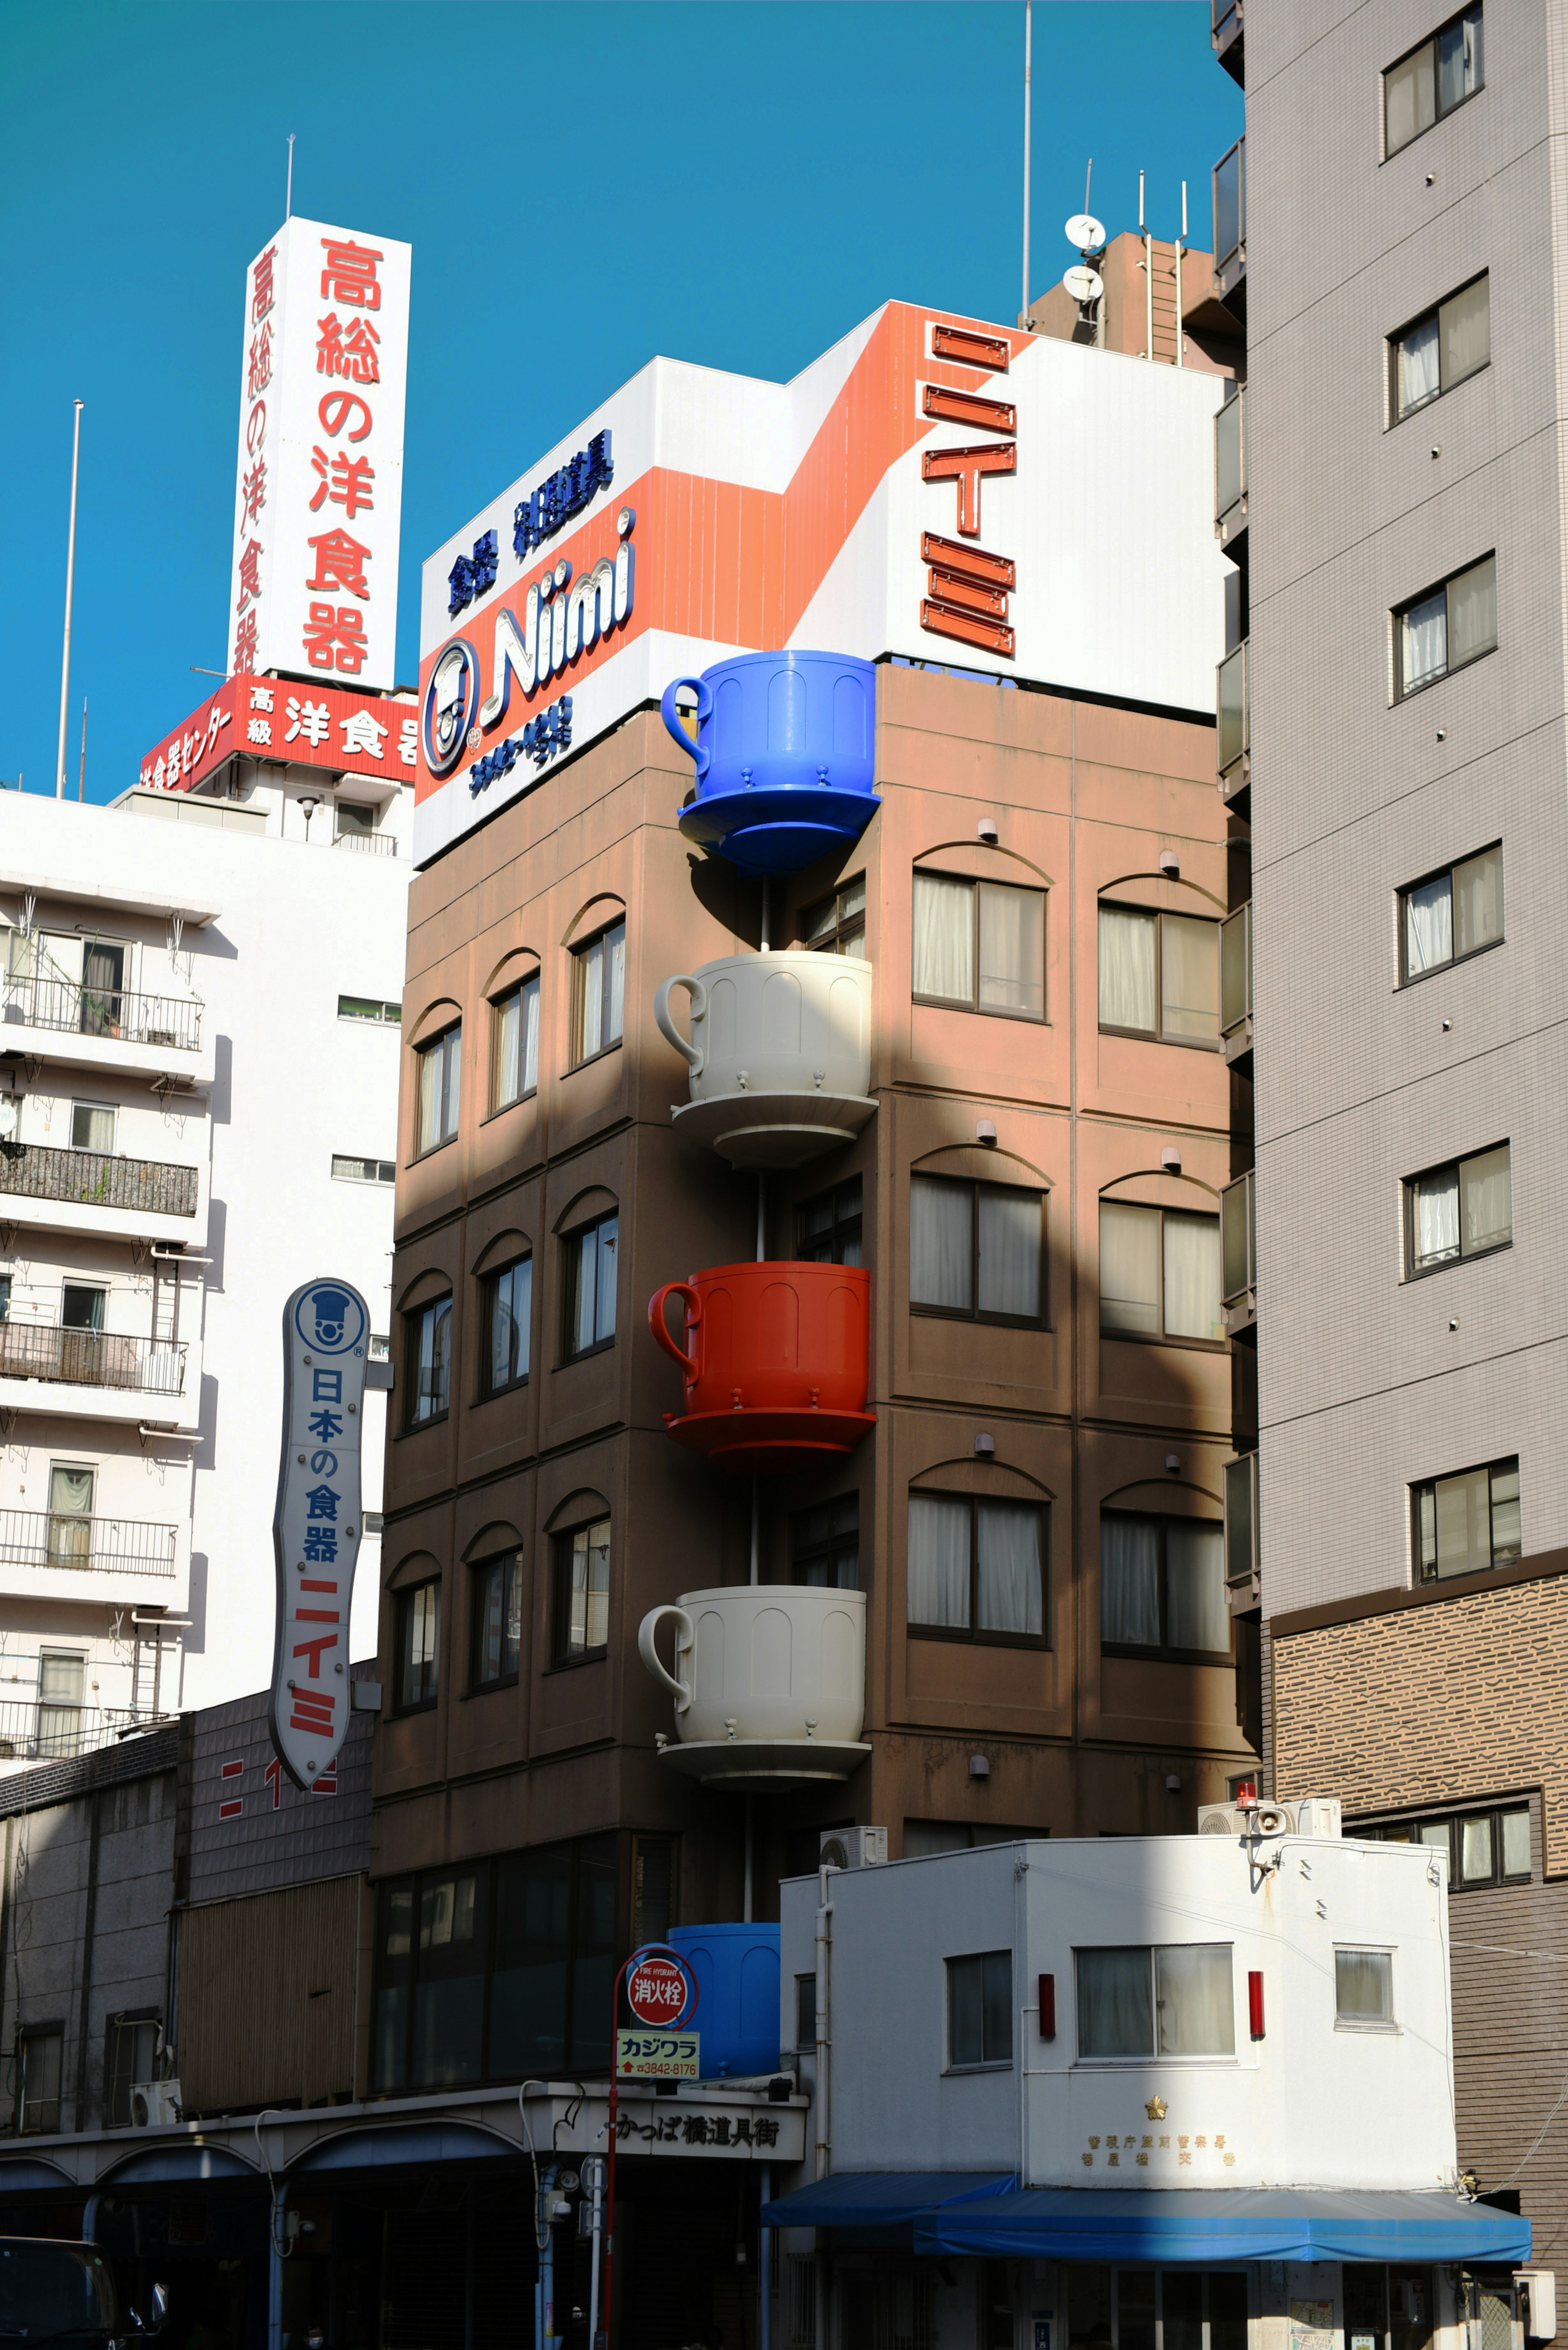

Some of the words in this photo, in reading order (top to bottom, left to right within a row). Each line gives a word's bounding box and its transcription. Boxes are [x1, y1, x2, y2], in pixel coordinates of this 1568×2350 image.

[303, 237, 384, 671] 高総の洋食器
[920, 325, 1016, 655] ニイミ
[479, 506, 636, 728] Niimi
[247, 686, 274, 746] 高級
[303, 1367, 344, 1563] 日本の食器
[290, 1579, 340, 1738] ニイミ
[634, 1978, 682, 2006] 消火栓
[640, 1967, 652, 1975] FIRE
[653, 1968, 678, 1977] HYDRANT
[621, 2038, 696, 2058] カジワラ
[616, 2114, 780, 2147] かっぱ橋道具街
[1088, 2134, 1227, 2149] 警視庁蔵前警察署
